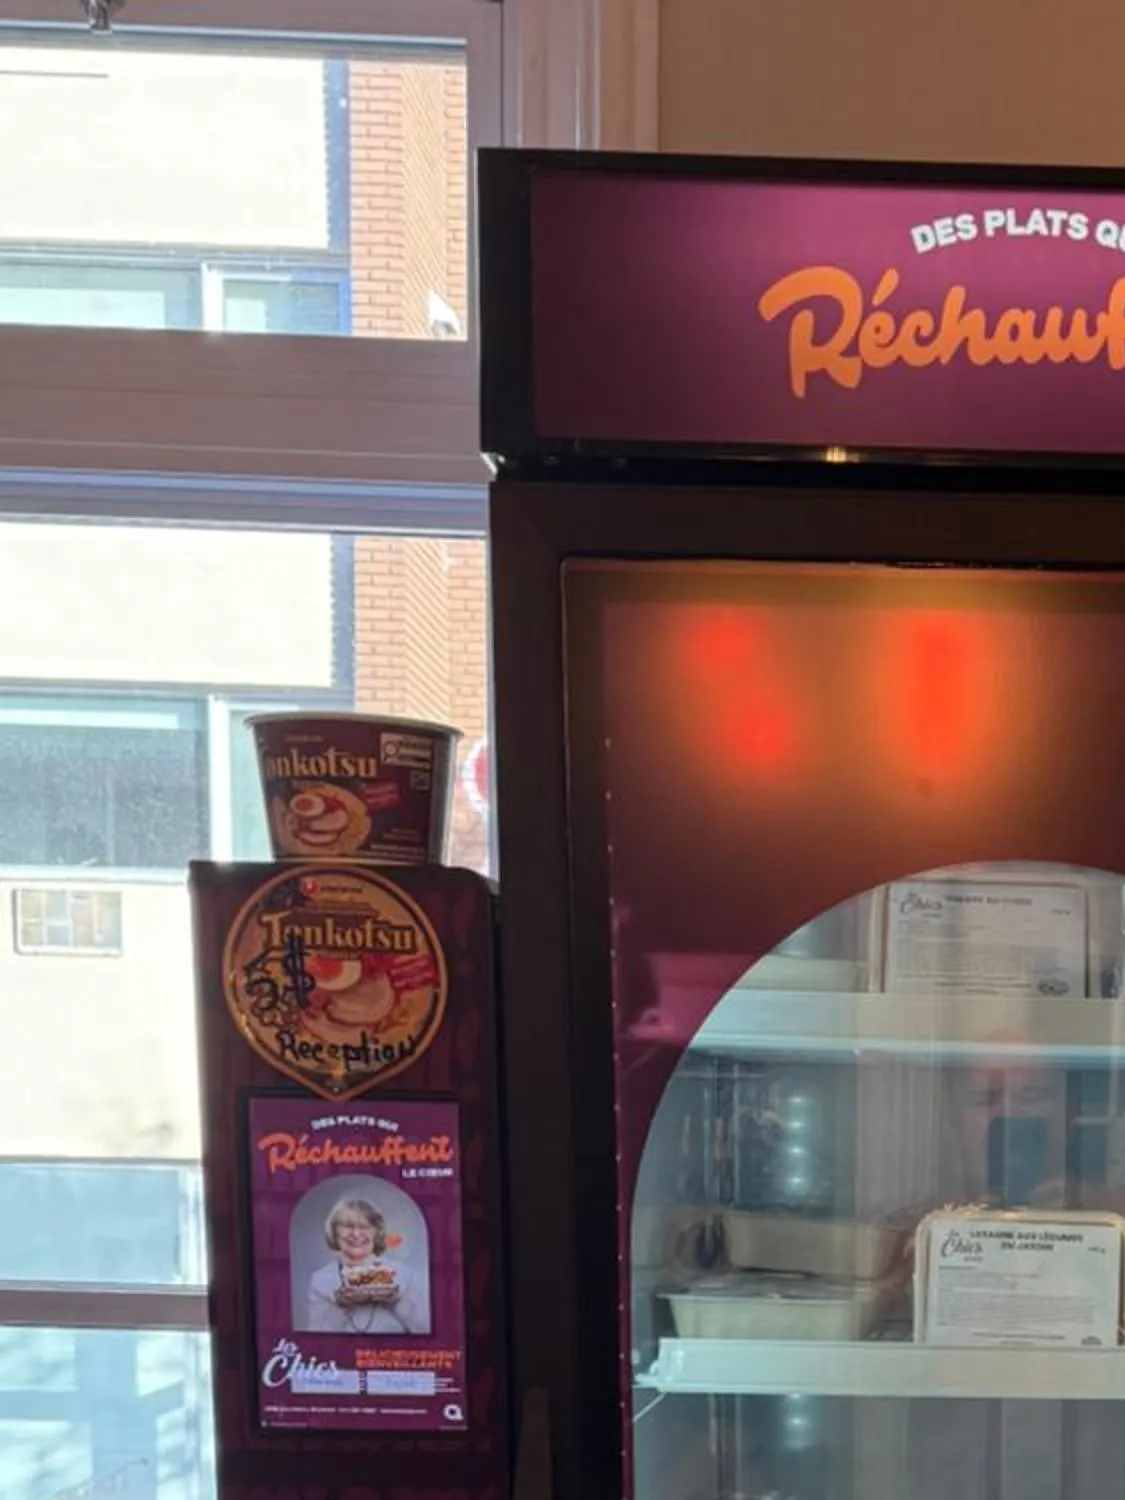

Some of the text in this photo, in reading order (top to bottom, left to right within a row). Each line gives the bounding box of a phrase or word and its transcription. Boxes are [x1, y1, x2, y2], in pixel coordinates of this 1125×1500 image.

[910, 213, 978, 254] DES
[983, 208, 1090, 240] PLATS
[257, 1132, 453, 1174] Réchauffent
